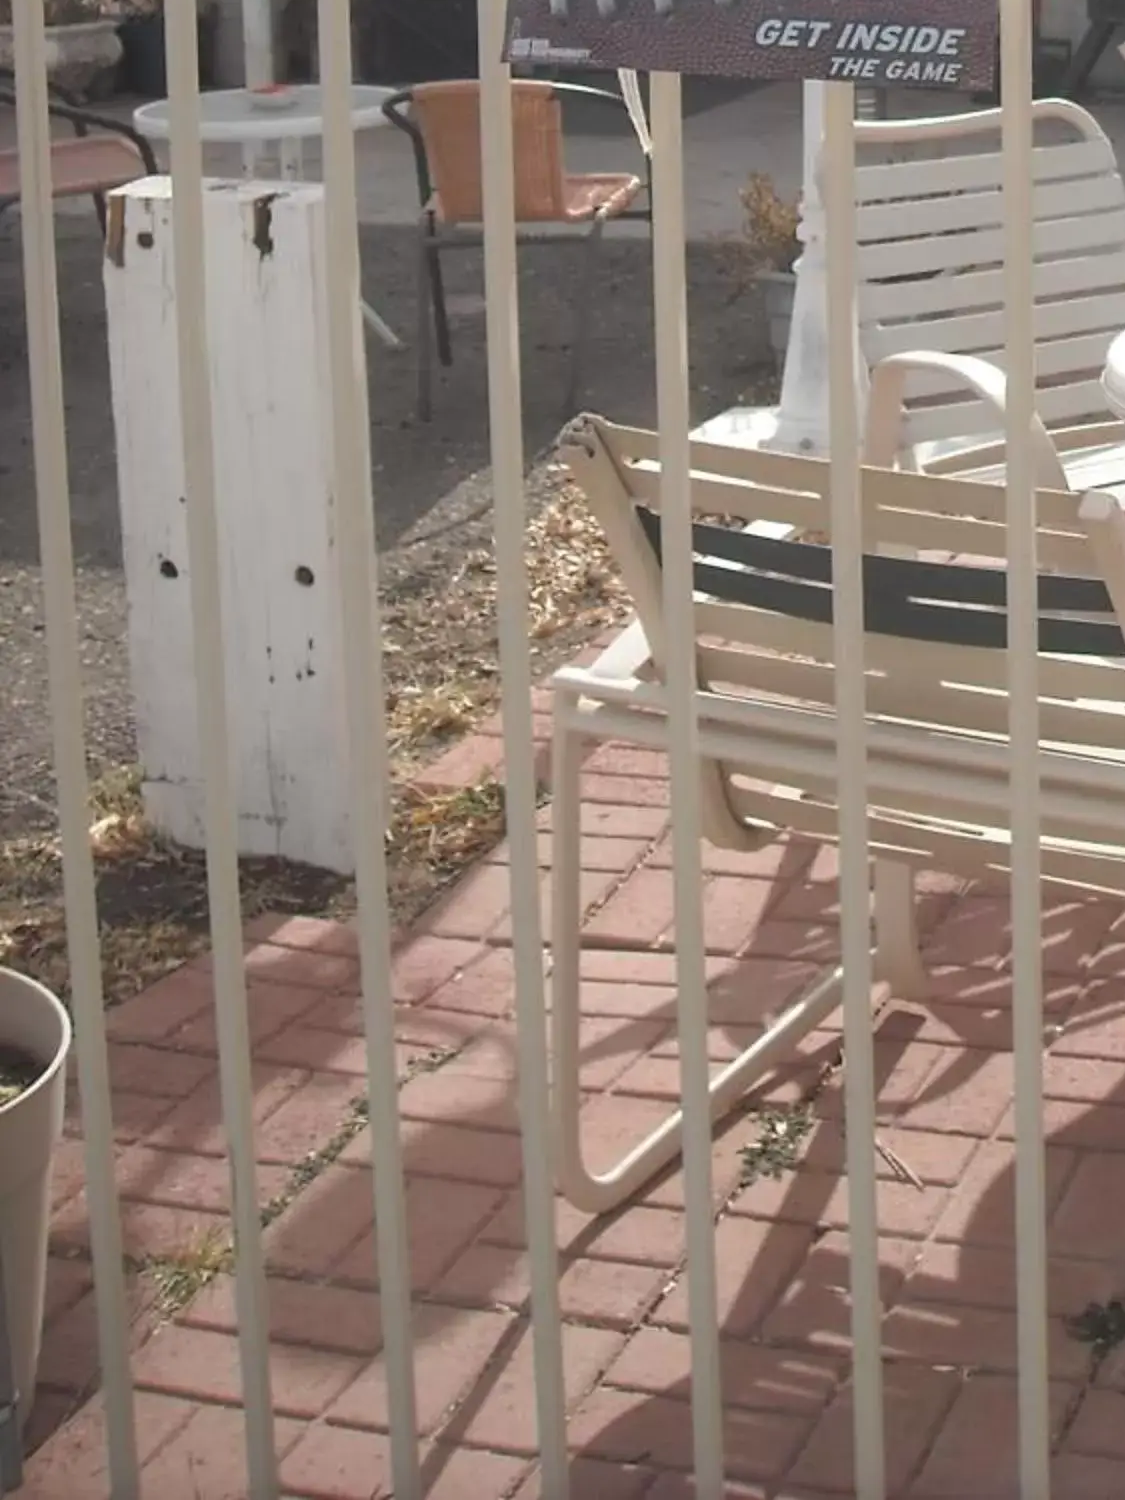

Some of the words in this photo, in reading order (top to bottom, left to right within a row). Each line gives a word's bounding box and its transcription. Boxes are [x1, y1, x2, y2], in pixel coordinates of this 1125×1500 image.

[755, 19, 832, 49] GET
[836, 23, 966, 56] INSIDE
[828, 56, 881, 79] THE
[885, 59, 963, 83] GAME
